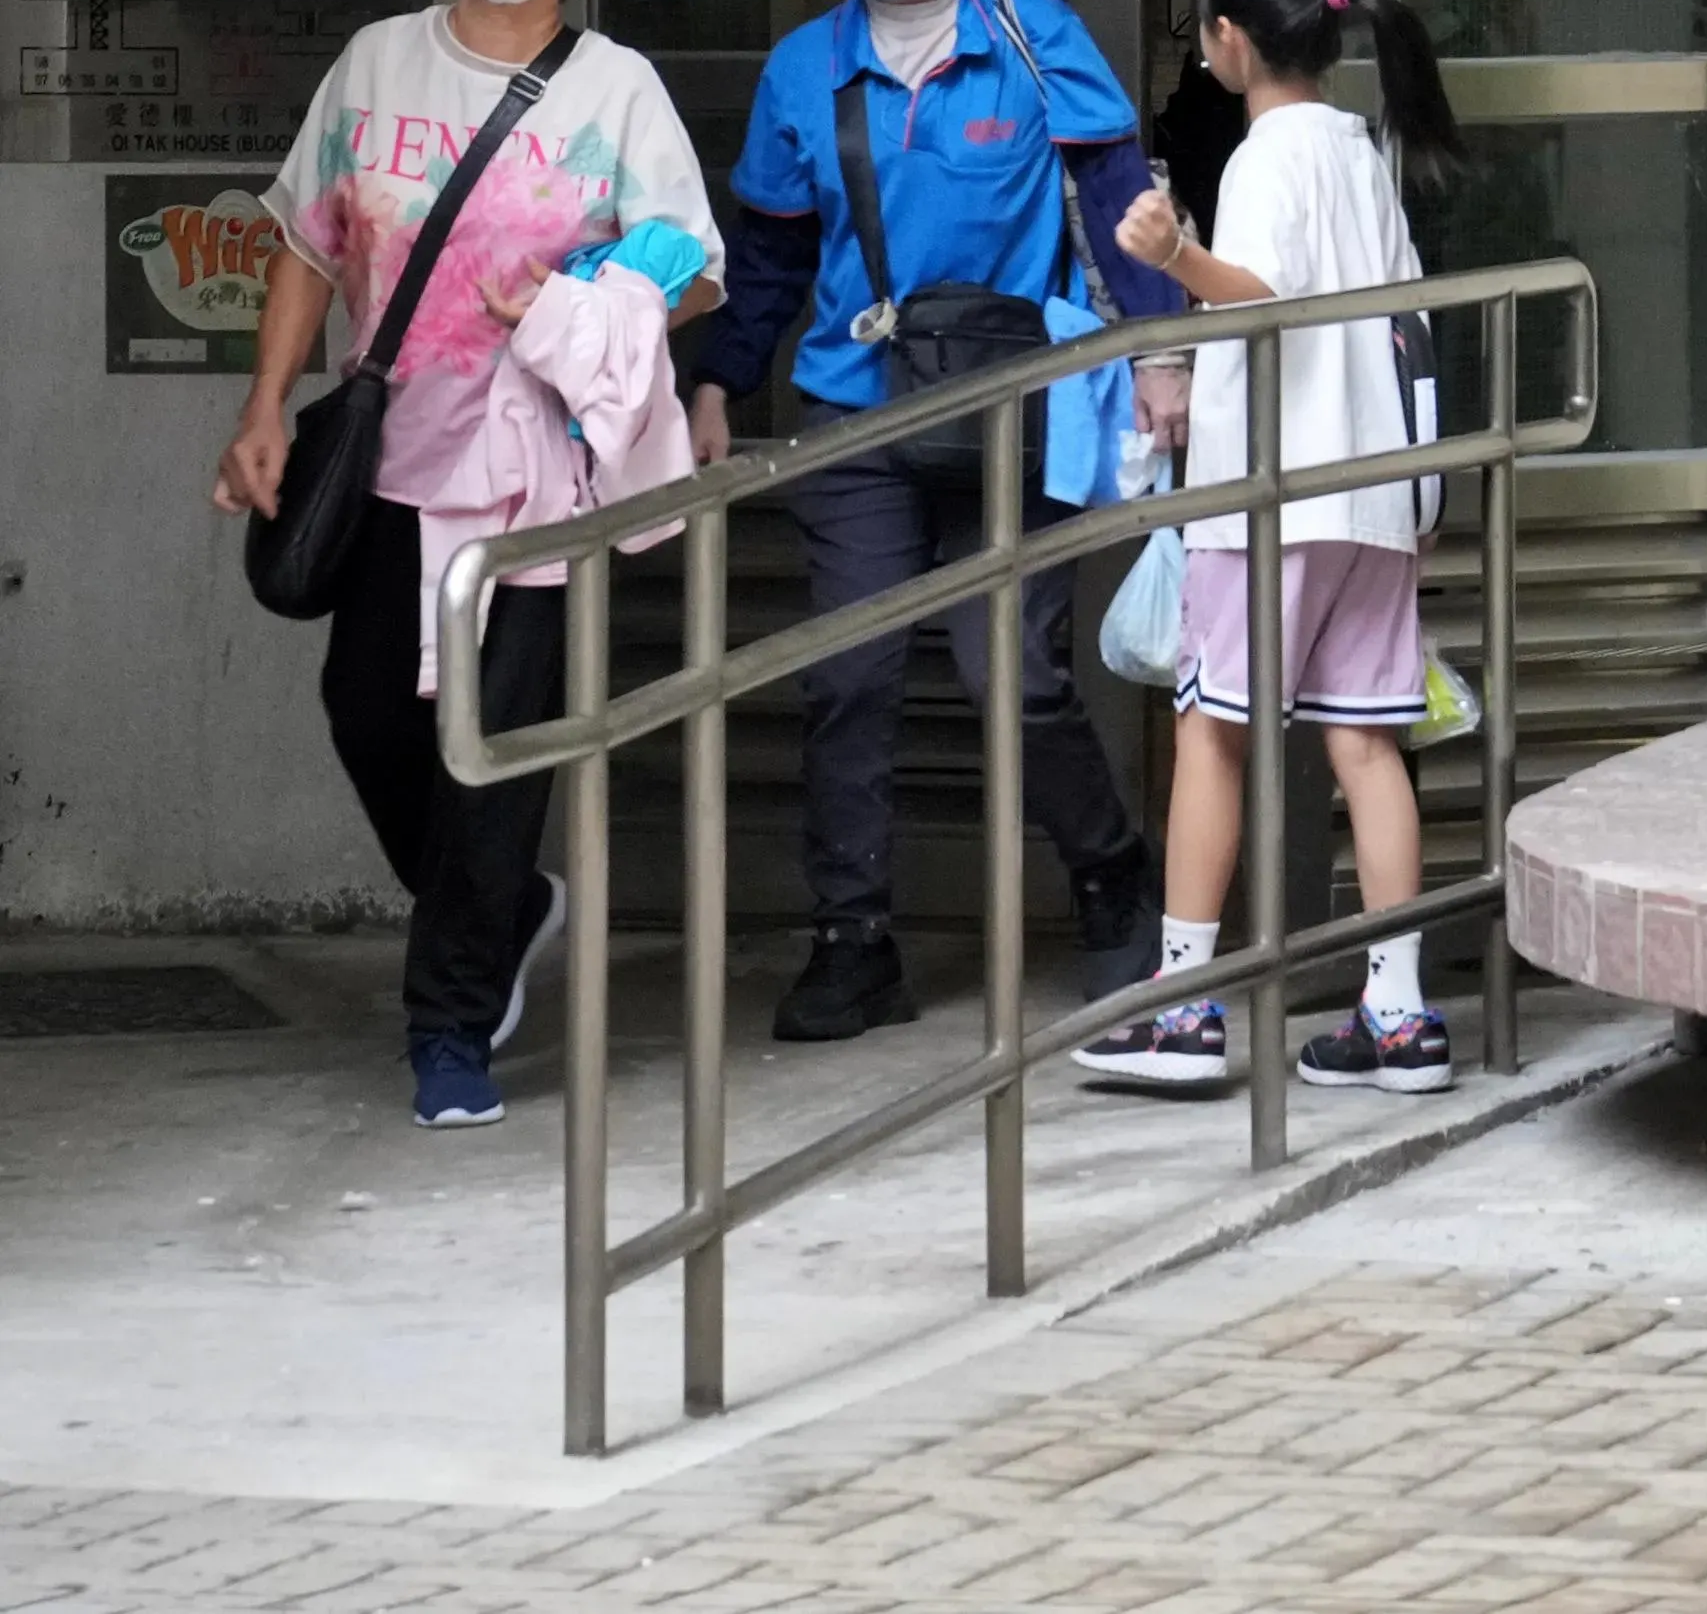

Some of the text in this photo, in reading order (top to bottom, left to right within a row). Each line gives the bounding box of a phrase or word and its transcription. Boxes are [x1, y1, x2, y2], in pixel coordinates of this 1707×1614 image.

[110, 134, 296, 154] OI TAK HOUSE (BLOC
[127, 229, 162, 244] Free
